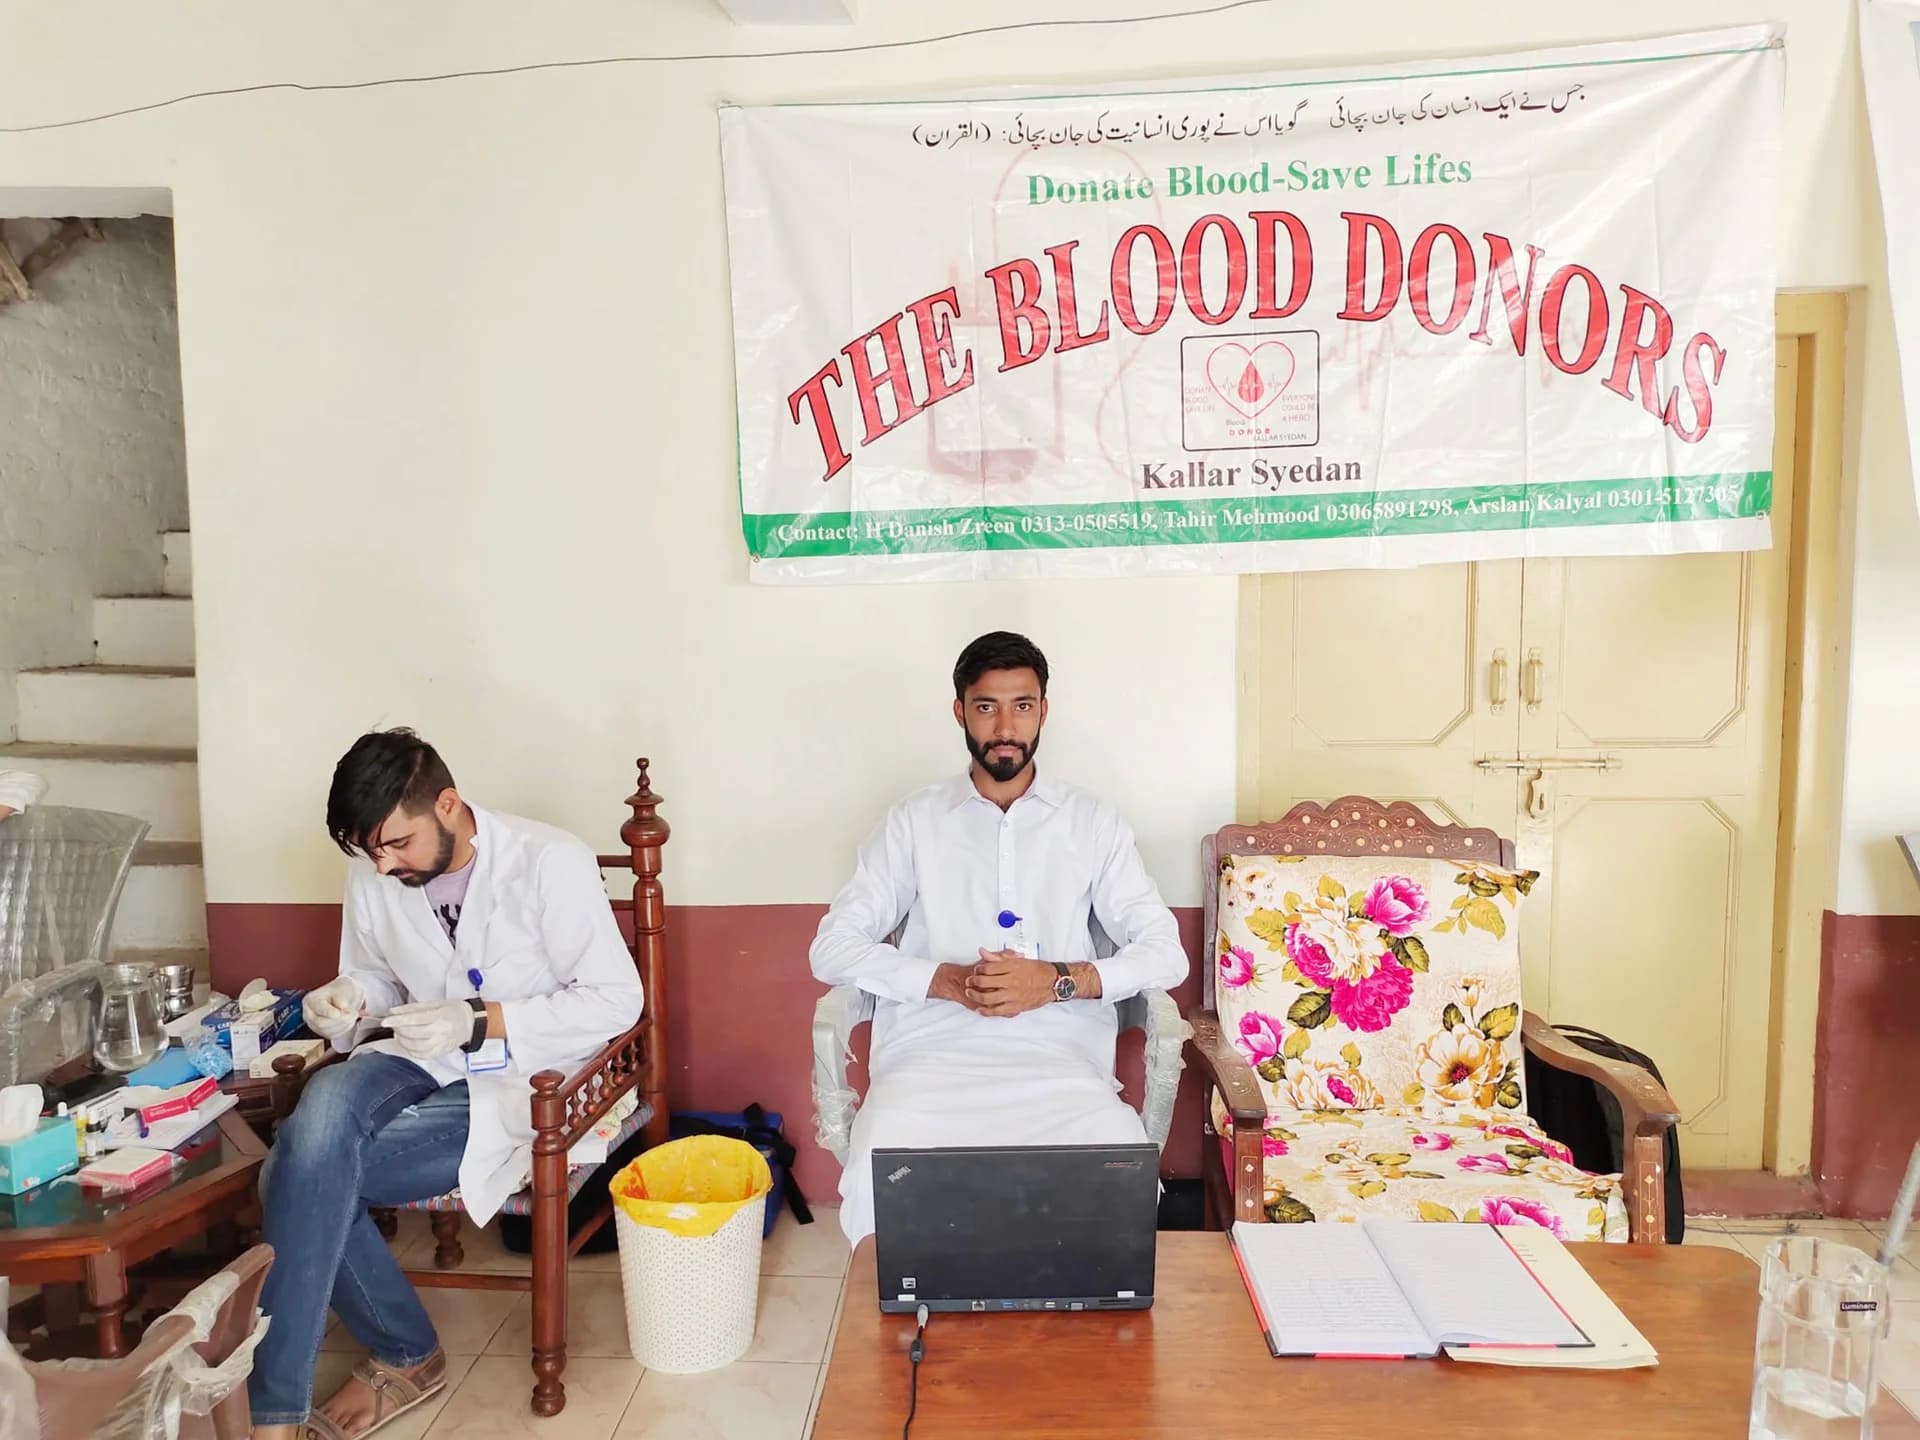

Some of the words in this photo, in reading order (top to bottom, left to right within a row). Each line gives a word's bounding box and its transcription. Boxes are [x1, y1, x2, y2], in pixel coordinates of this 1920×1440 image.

[1411, 92, 1433, 120] کی
[1431, 96, 1479, 119] انسان
[1481, 92, 1515, 119] ایک
[1519, 92, 1547, 111] نے
[1551, 83, 1585, 113] جس
[1087, 110, 1110, 144] کی
[1106, 114, 1169, 143] انسانیت
[1172, 115, 1210, 143] پوری
[1213, 112, 1241, 136] نے
[1372, 107, 1406, 125] جان
[1049, 122, 1083, 146] جان
[1027, 171, 1154, 205] Donate
[1166, 159, 1372, 198] Blood-Save
[1384, 152, 1473, 187] Lifes
[787, 287, 975, 483] THE
[985, 210, 1314, 373] BLOOD
[1336, 211, 1728, 444] DONORS
[1140, 462, 1242, 489] Kallar
[1251, 456, 1362, 491] Syedan
[865, 521, 883, 538] H
[888, 519, 955, 538] Danish
[960, 518, 1015, 535] Zreen
[1021, 512, 1158, 533] 0313-0505519,
[1163, 511, 1217, 528] Tahir
[1223, 506, 1320, 526] Mehmood
[1326, 499, 1459, 521] 03065891298,
[1464, 496, 1531, 515] Arslan
[1537, 491, 1601, 514] Kalyal
[1608, 484, 1739, 508] 0301-5127305
